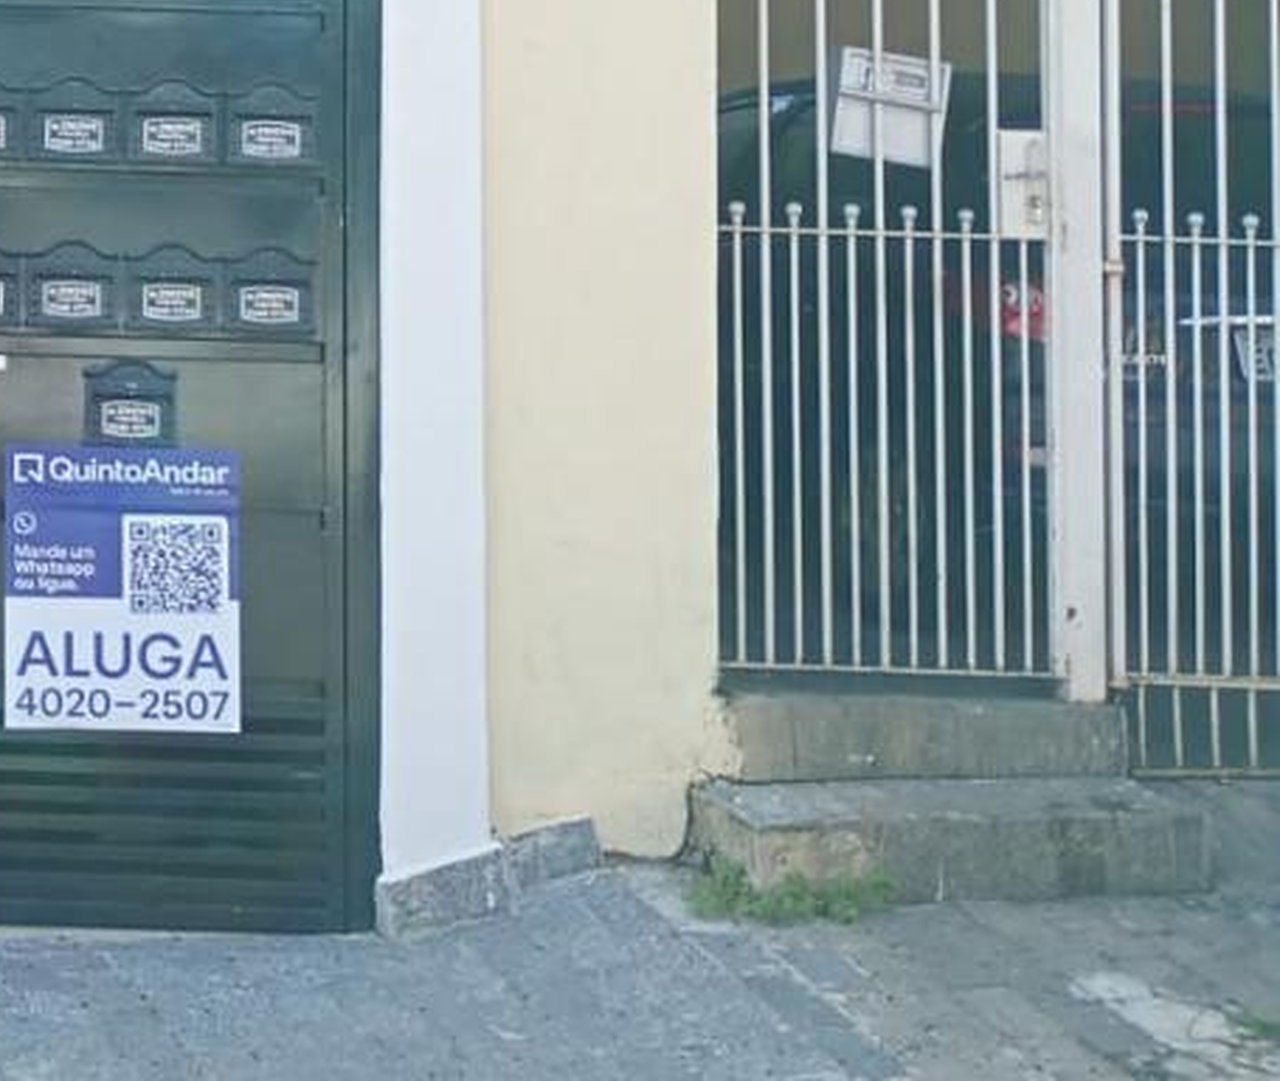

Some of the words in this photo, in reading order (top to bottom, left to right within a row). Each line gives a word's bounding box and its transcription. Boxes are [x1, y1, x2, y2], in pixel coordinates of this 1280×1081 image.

[48, 455, 230, 485] QuintoAndar
[16, 630, 228, 680] ALUGA
[15, 687, 230, 721] 4020-2507
